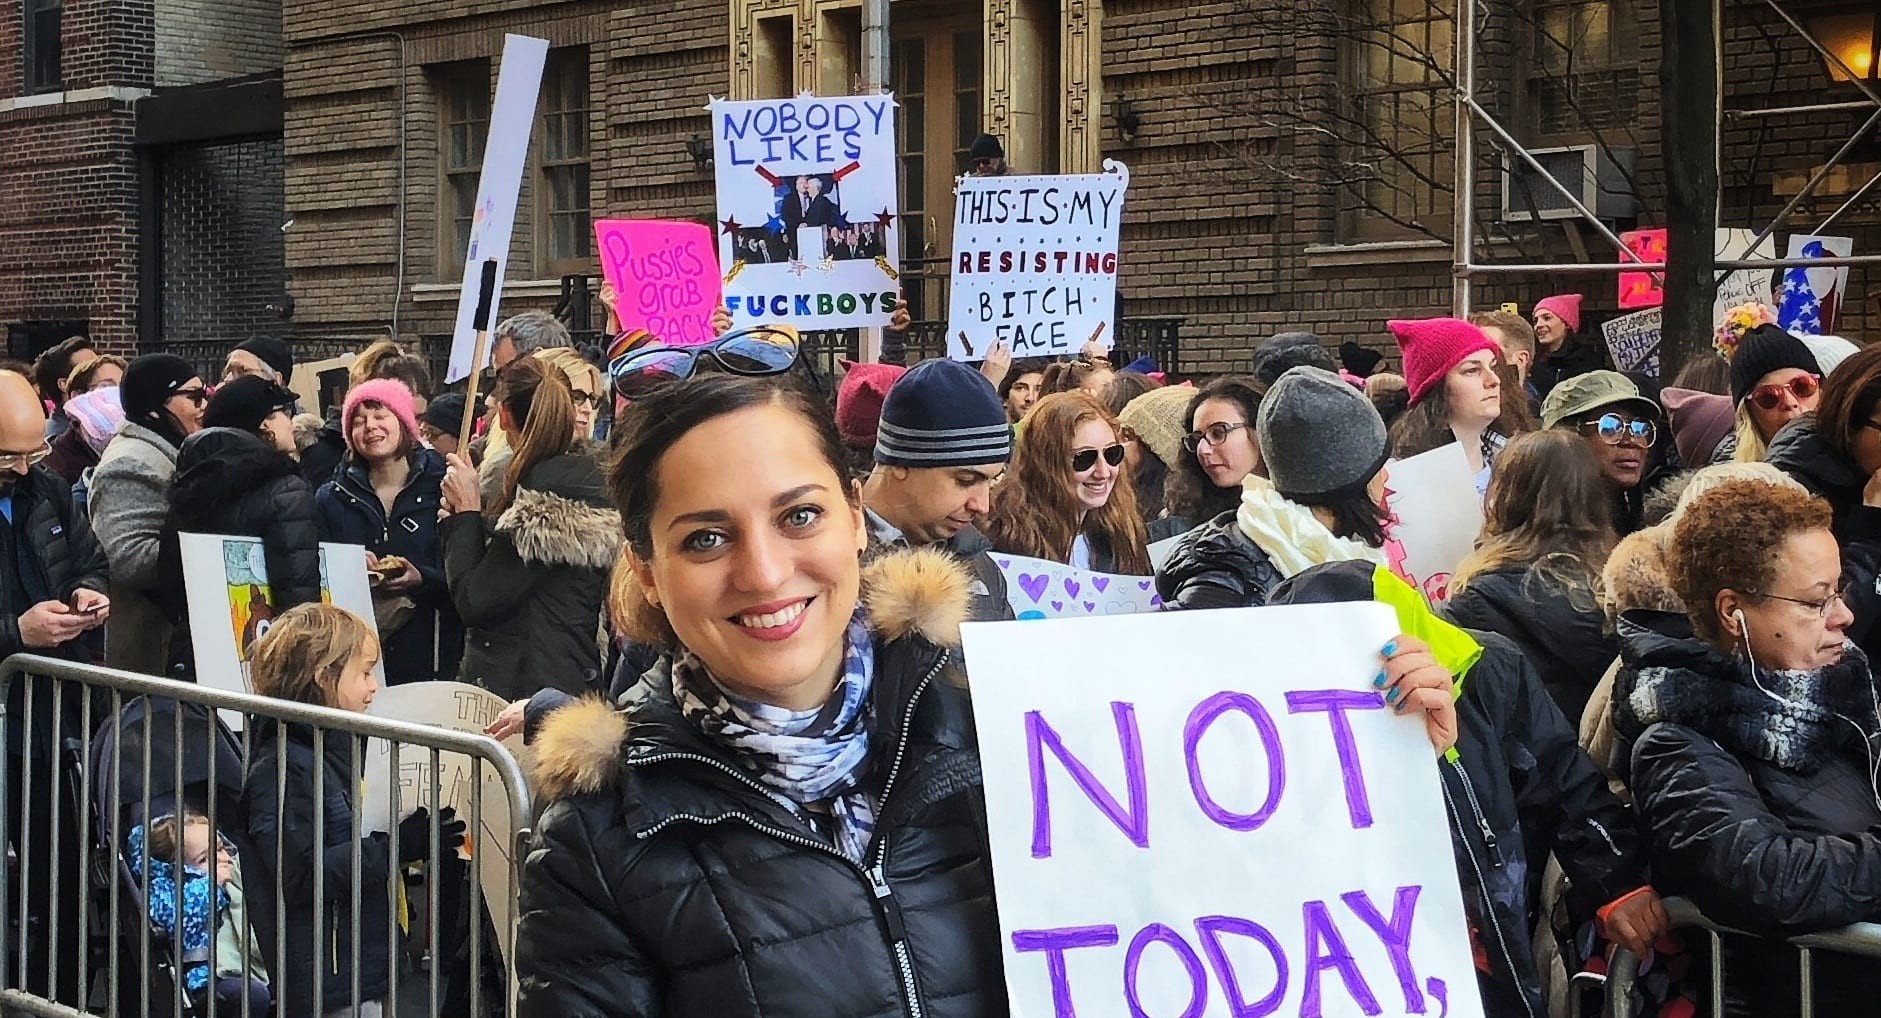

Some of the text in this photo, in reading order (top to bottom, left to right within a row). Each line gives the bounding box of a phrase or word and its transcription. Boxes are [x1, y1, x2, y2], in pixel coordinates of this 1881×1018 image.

[724, 101, 885, 140] NOBODY
[730, 130, 862, 165] LIKES
[959, 188, 1117, 229] THIS IS MY
[604, 230, 704, 293] Pussies
[959, 251, 1116, 274] RESISTING
[726, 292, 897, 317] FUCKBOYS
[979, 287, 1083, 322] BITCH
[645, 309, 713, 344] BACK
[996, 321, 1068, 352] FACE
[1024, 689, 1386, 859] NOT
